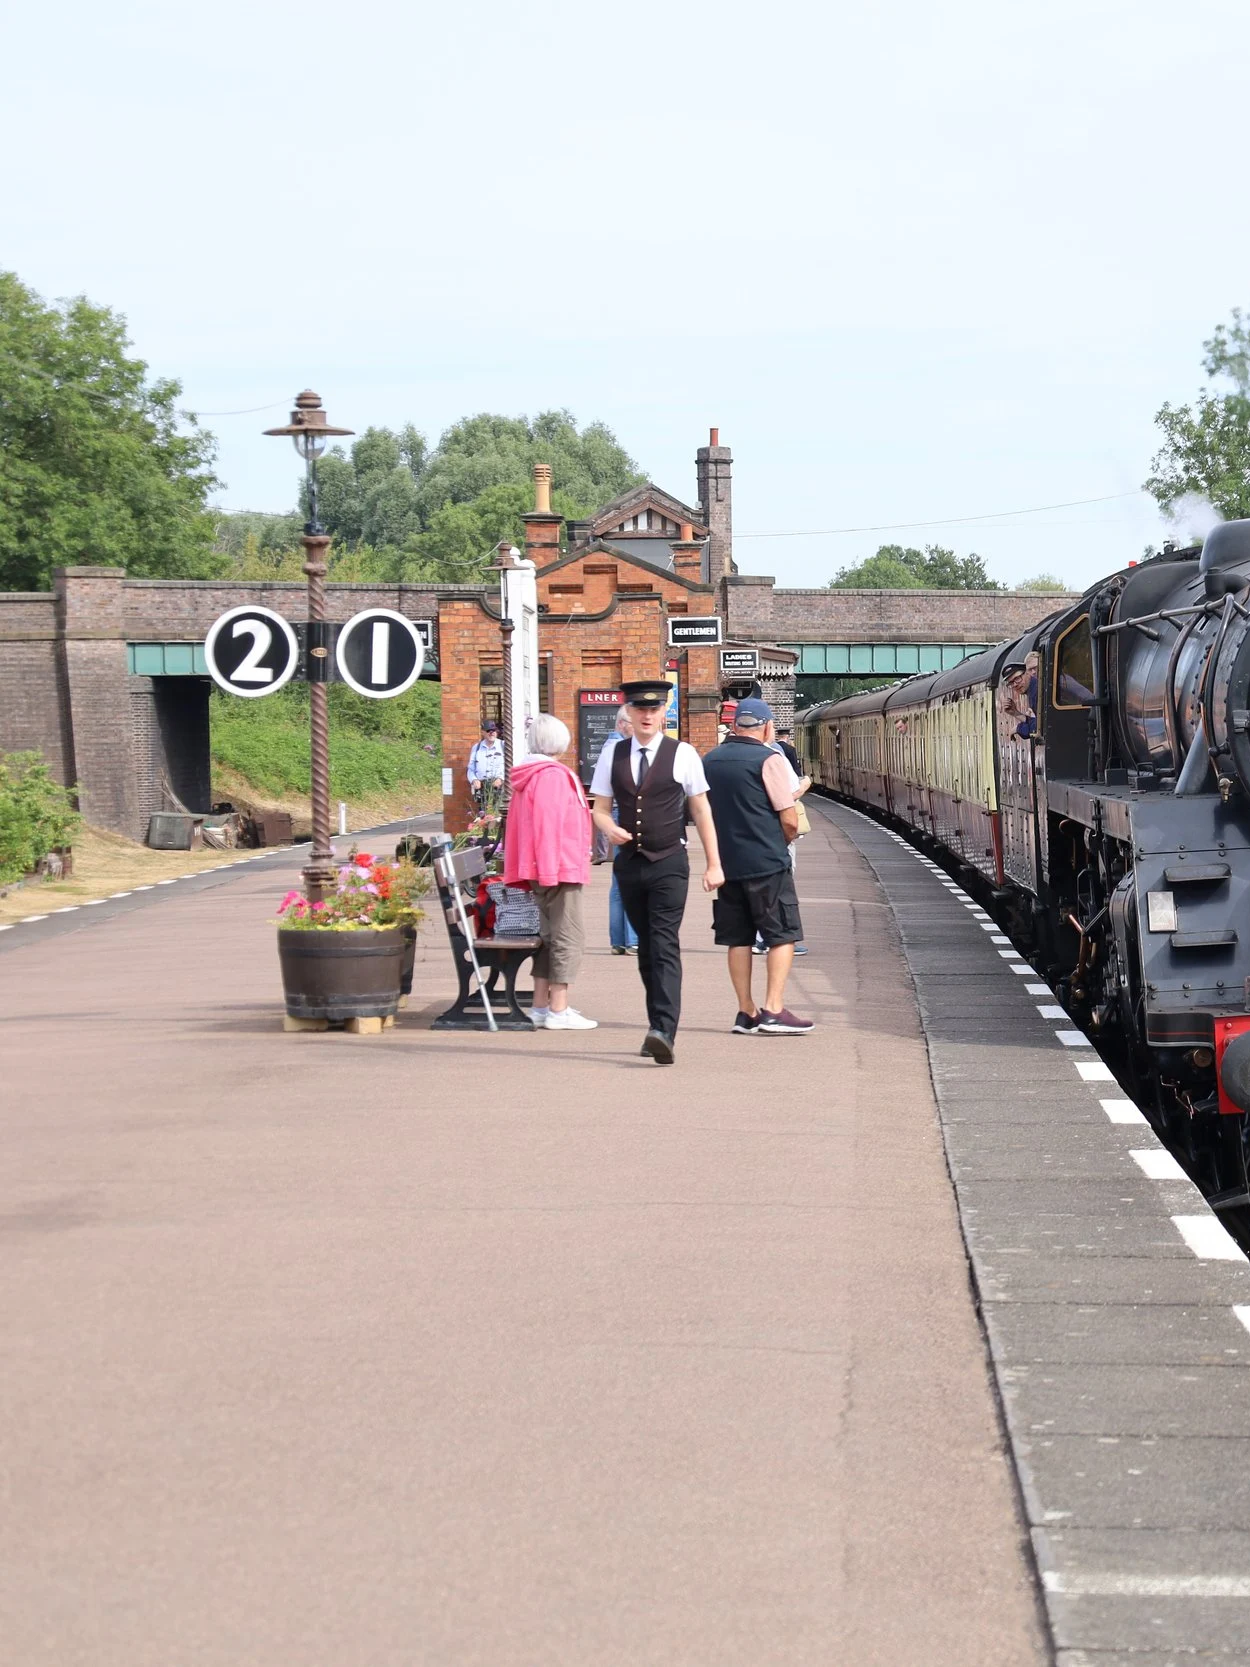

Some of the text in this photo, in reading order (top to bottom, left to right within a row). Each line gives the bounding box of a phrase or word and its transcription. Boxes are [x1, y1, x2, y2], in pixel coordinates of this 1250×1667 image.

[673, 627, 717, 636] GENTLEMEN
[230, 619, 273, 682] 2
[587, 693, 619, 702] LNER
